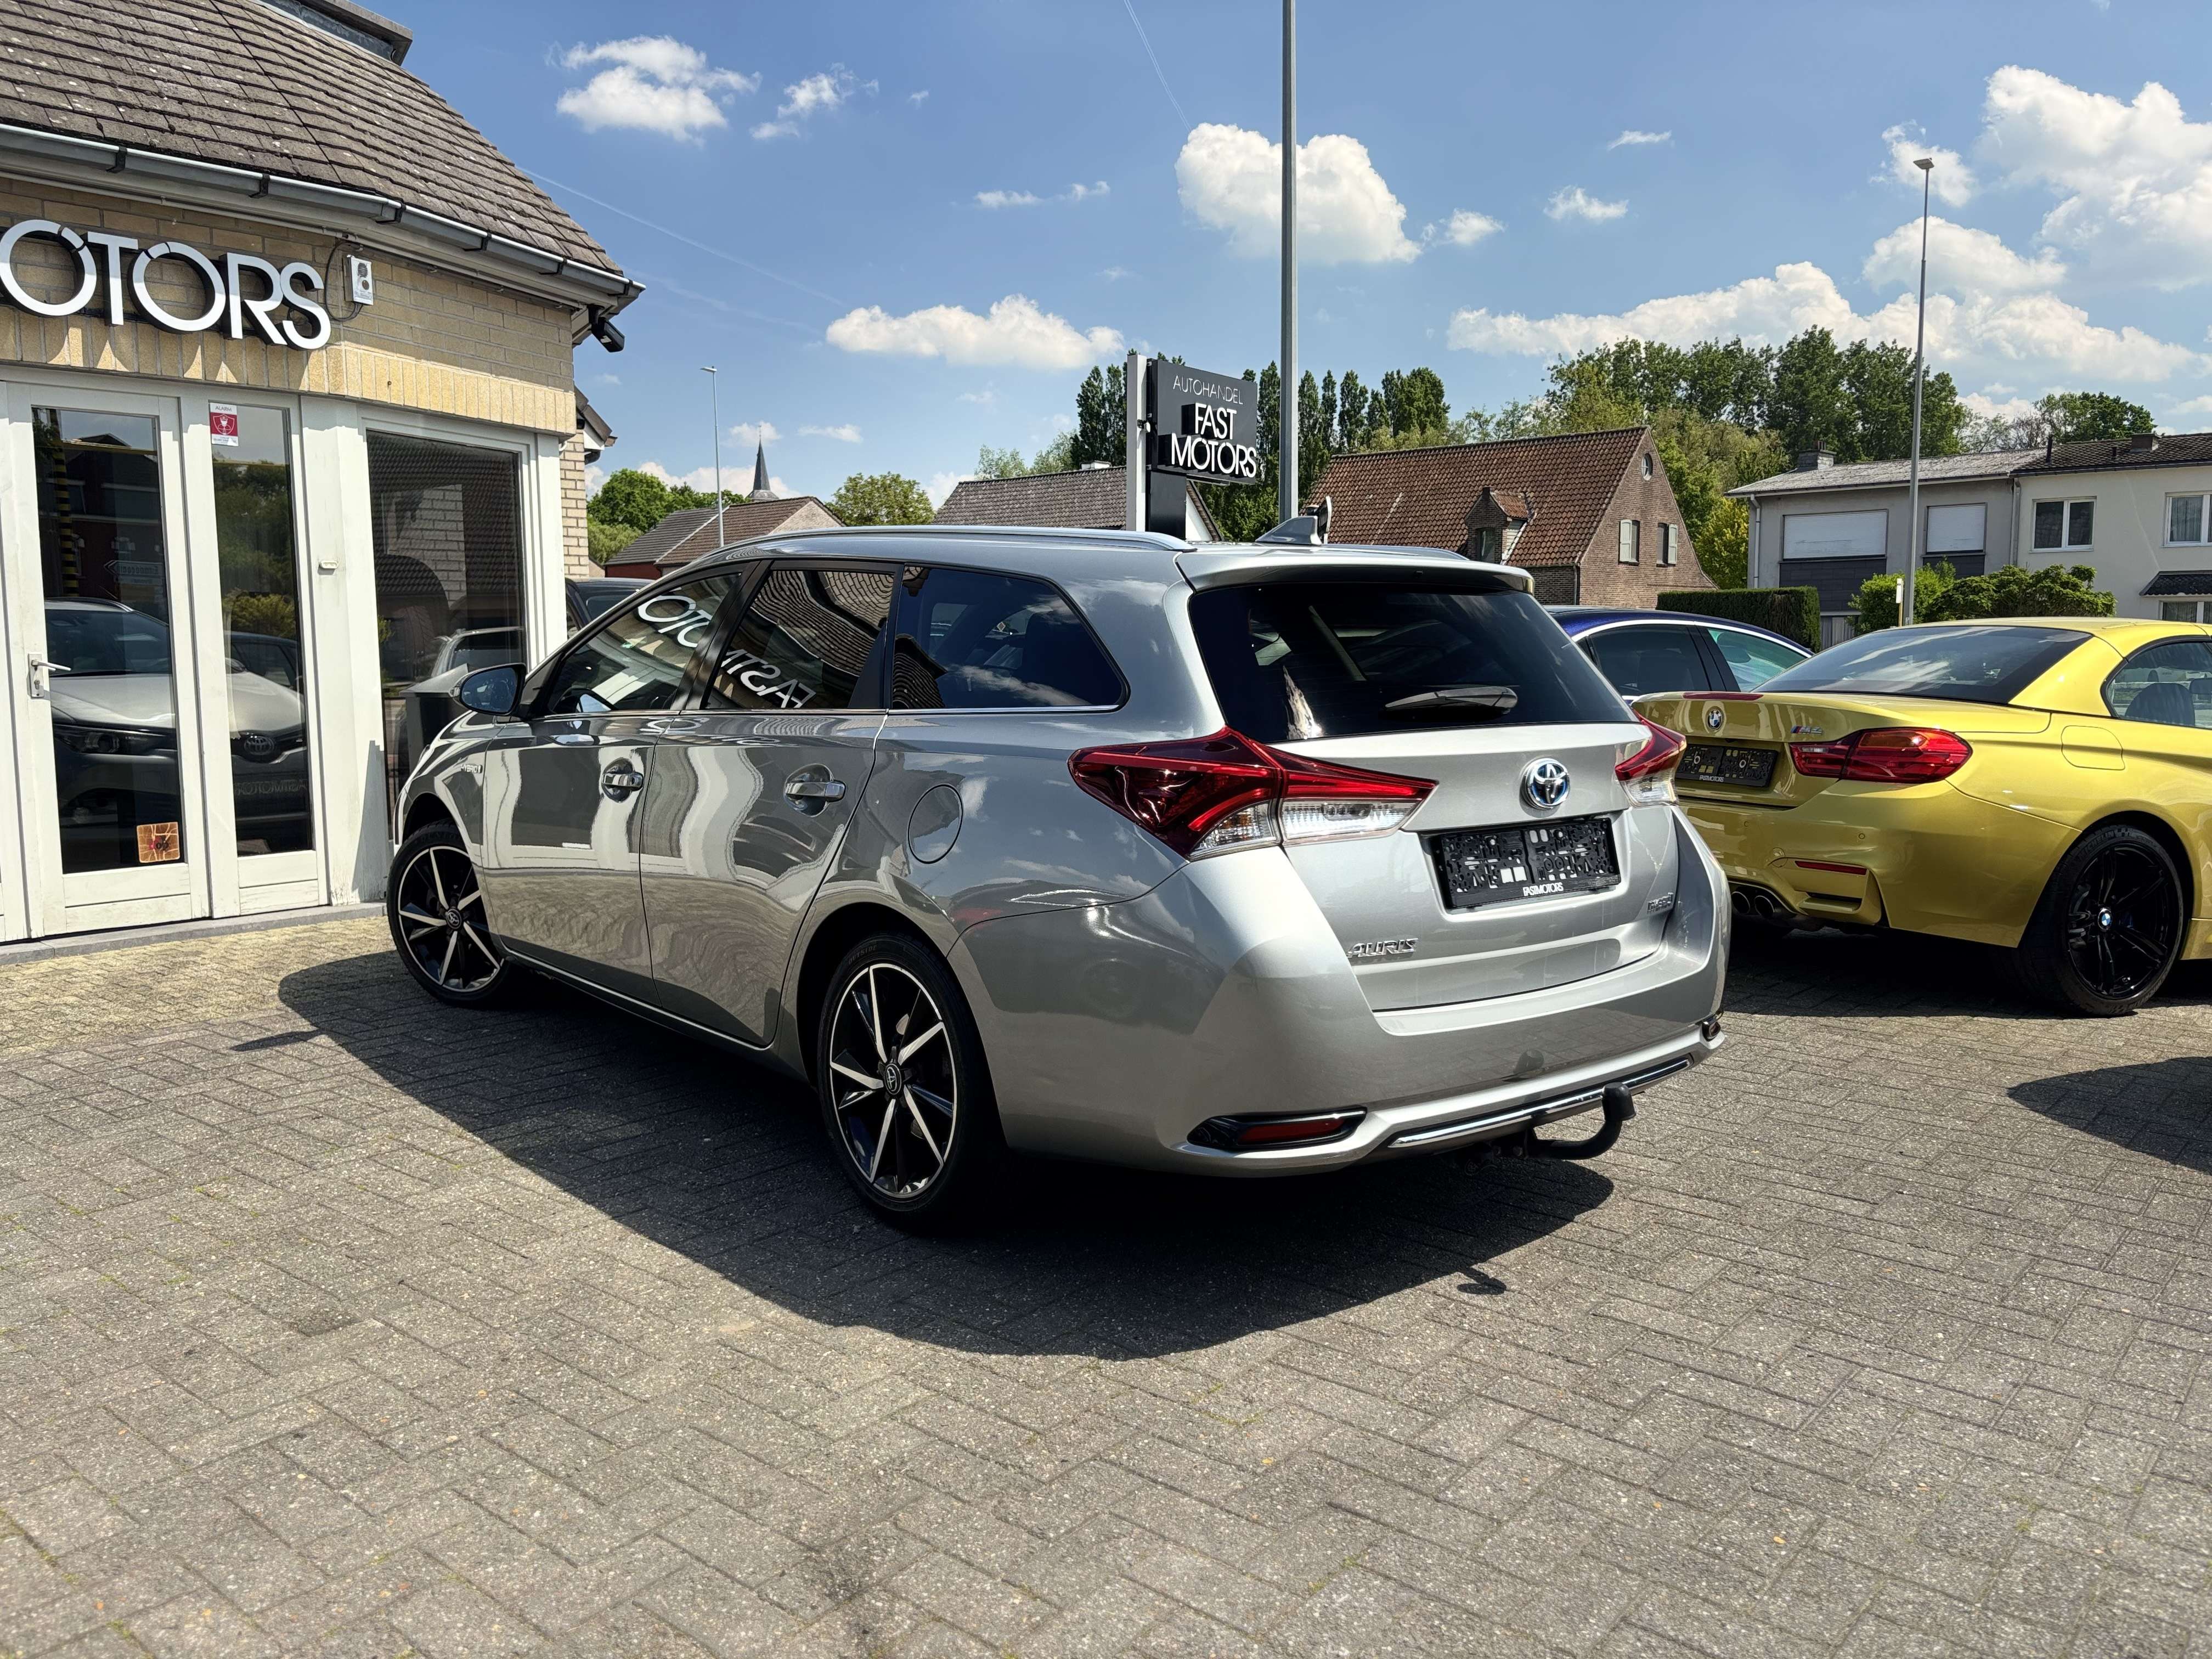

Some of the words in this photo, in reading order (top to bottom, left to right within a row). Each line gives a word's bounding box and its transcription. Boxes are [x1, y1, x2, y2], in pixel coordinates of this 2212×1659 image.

[1172, 375, 1243, 405] AUTOHANDEL
[1194, 402, 1237, 440] FAST
[1171, 433, 1257, 478] MOTORS
[1346, 938, 1419, 958] AURIS
